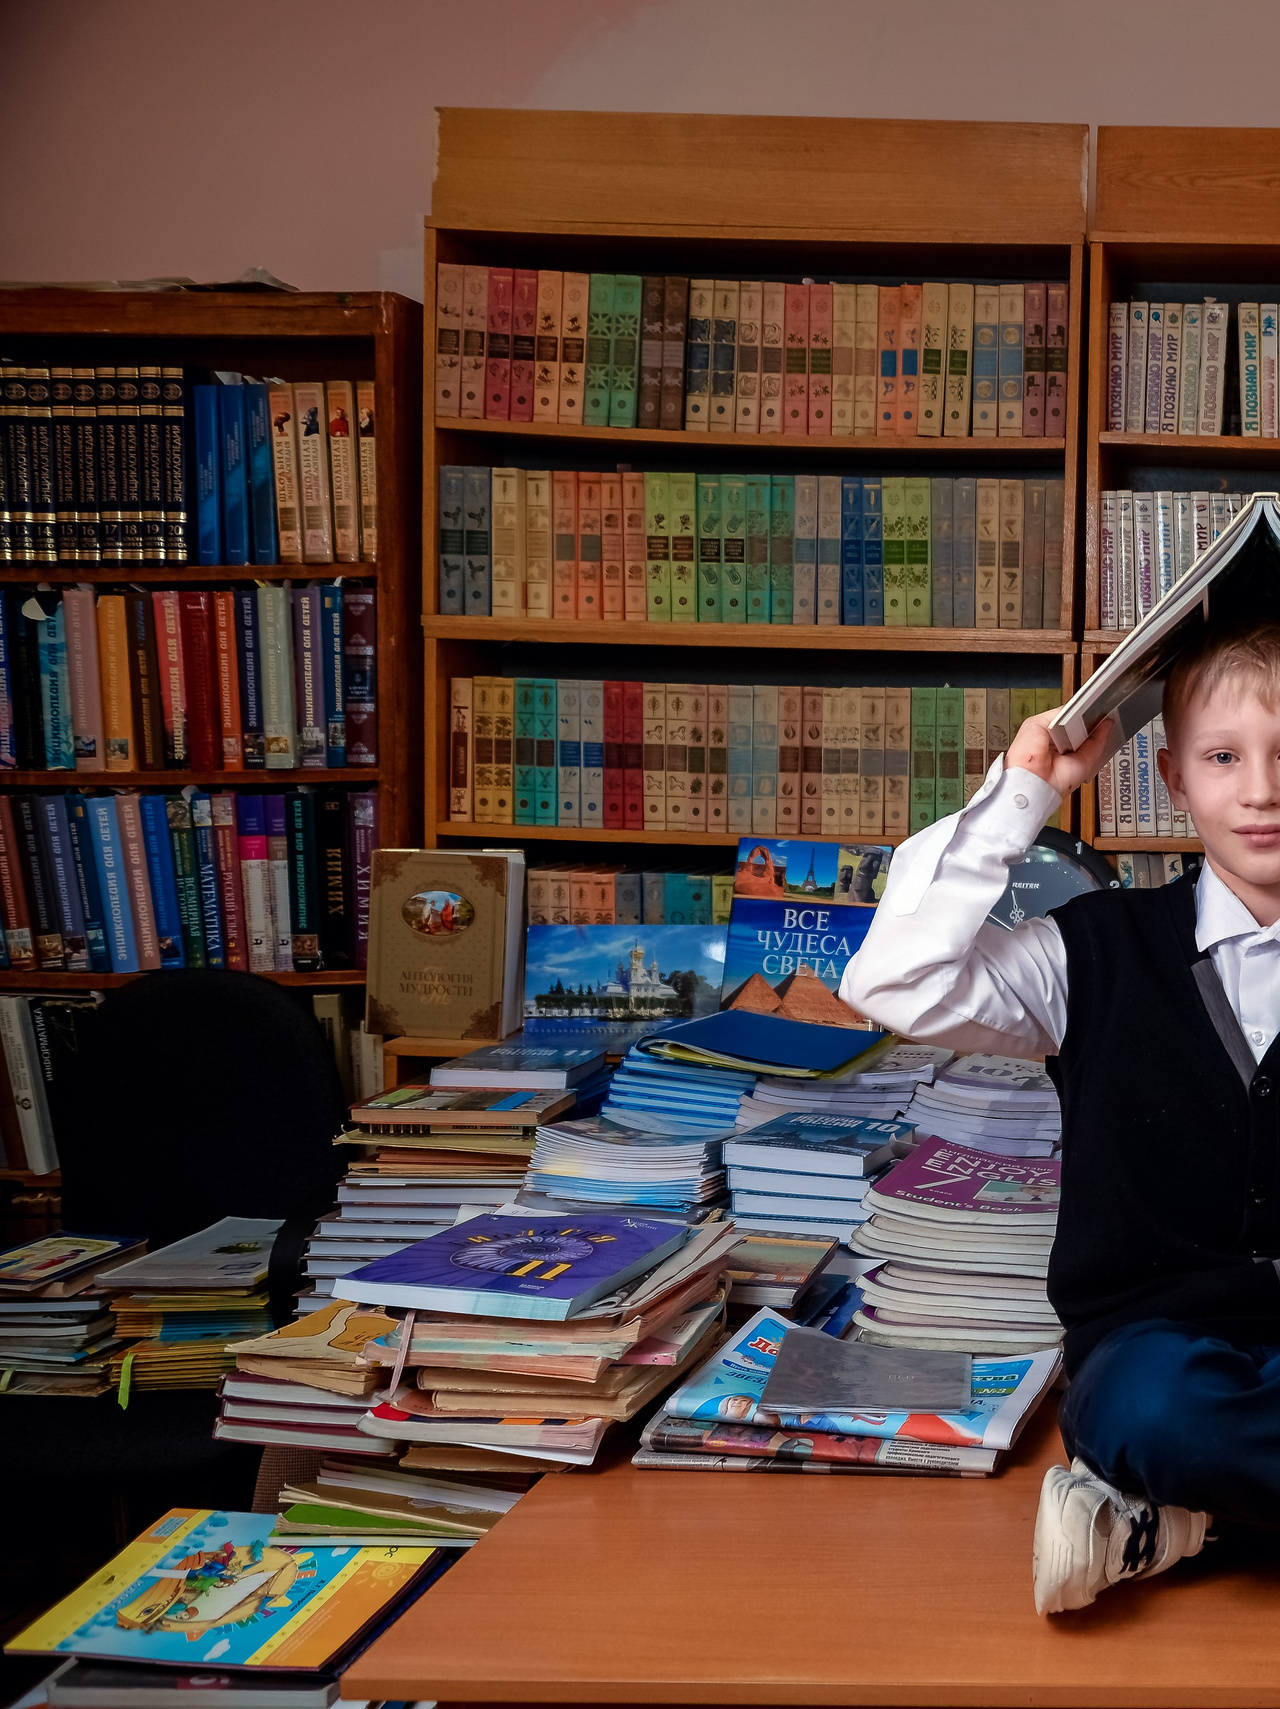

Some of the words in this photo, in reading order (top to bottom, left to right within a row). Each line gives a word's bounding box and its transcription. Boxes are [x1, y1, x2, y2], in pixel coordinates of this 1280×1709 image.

[1166, 333, 1178, 362] МИР
[1164, 364, 1177, 419] ПОЗНАЮ
[1162, 423, 1174, 433] Я
[276, 441, 286, 502] ШКОЛЬНАЯ
[302, 440, 313, 501] ШКОЛЬНАЯ
[333, 439, 343, 501] ШКОЛЬНАЯ
[61, 525, 73, 535] 15
[82, 525, 95, 535] 16
[105, 524, 118, 534] 17
[124, 524, 137, 535] 18
[146, 524, 159, 534] 19
[167, 638, 177, 661] ДЛЯ
[219, 631, 228, 649] ДЛЯ
[303, 630, 311, 648] ДЛЯ
[220, 653, 231, 728] ЭНЦИКЛОПЕДИЯ
[245, 652, 257, 727] ЭНЦИКЛОПЕДИЯ
[304, 651, 314, 726] ЭНЦИКЛОПЕДИЯ
[169, 667, 184, 760] ЭНЦИКЛОПЕДИЯ
[1136, 733, 1148, 759] МИР
[1138, 761, 1150, 811] ПОЗНАЮ
[95, 807, 111, 841] ДЕТЕЙ
[1139, 813, 1151, 823] Я
[102, 845, 115, 868] ДЛЯ
[222, 871, 236, 912] РУССКИЙ
[325, 848, 344, 916] ХИМИЯ
[1011, 881, 1040, 890] REITER
[176, 878, 189, 925] ИСТОРИЯ
[184, 877, 200, 937] ВСЕМИРНАЯ
[200, 863, 221, 951] МАТЕМАТИКА
[357, 864, 371, 941] ХИМИЯ
[106, 872, 127, 960] ЭНЦИКЛОПЕДИЯ
[226, 912, 237, 940] ЯЗЫК
[783, 908, 831, 931] ВСЕ
[757, 930, 852, 957] ЧУДЕСА
[401, 970, 473, 984] АНТОЛОГИЯ
[762, 954, 838, 979] СВЕТА
[399, 982, 473, 997] МУДРОСТИ
[33, 1007, 54, 1081] ИНФОРМАТИКА
[865, 1122, 901, 1133] 10
[914, 1164, 971, 1190] 7
[925, 1159, 1058, 1187] ENGLIS
[933, 1150, 1051, 1177] ENJOY
[895, 1189, 974, 1210] Student's
[979, 1204, 1024, 1213] Book
[506, 1259, 572, 1280] 11
